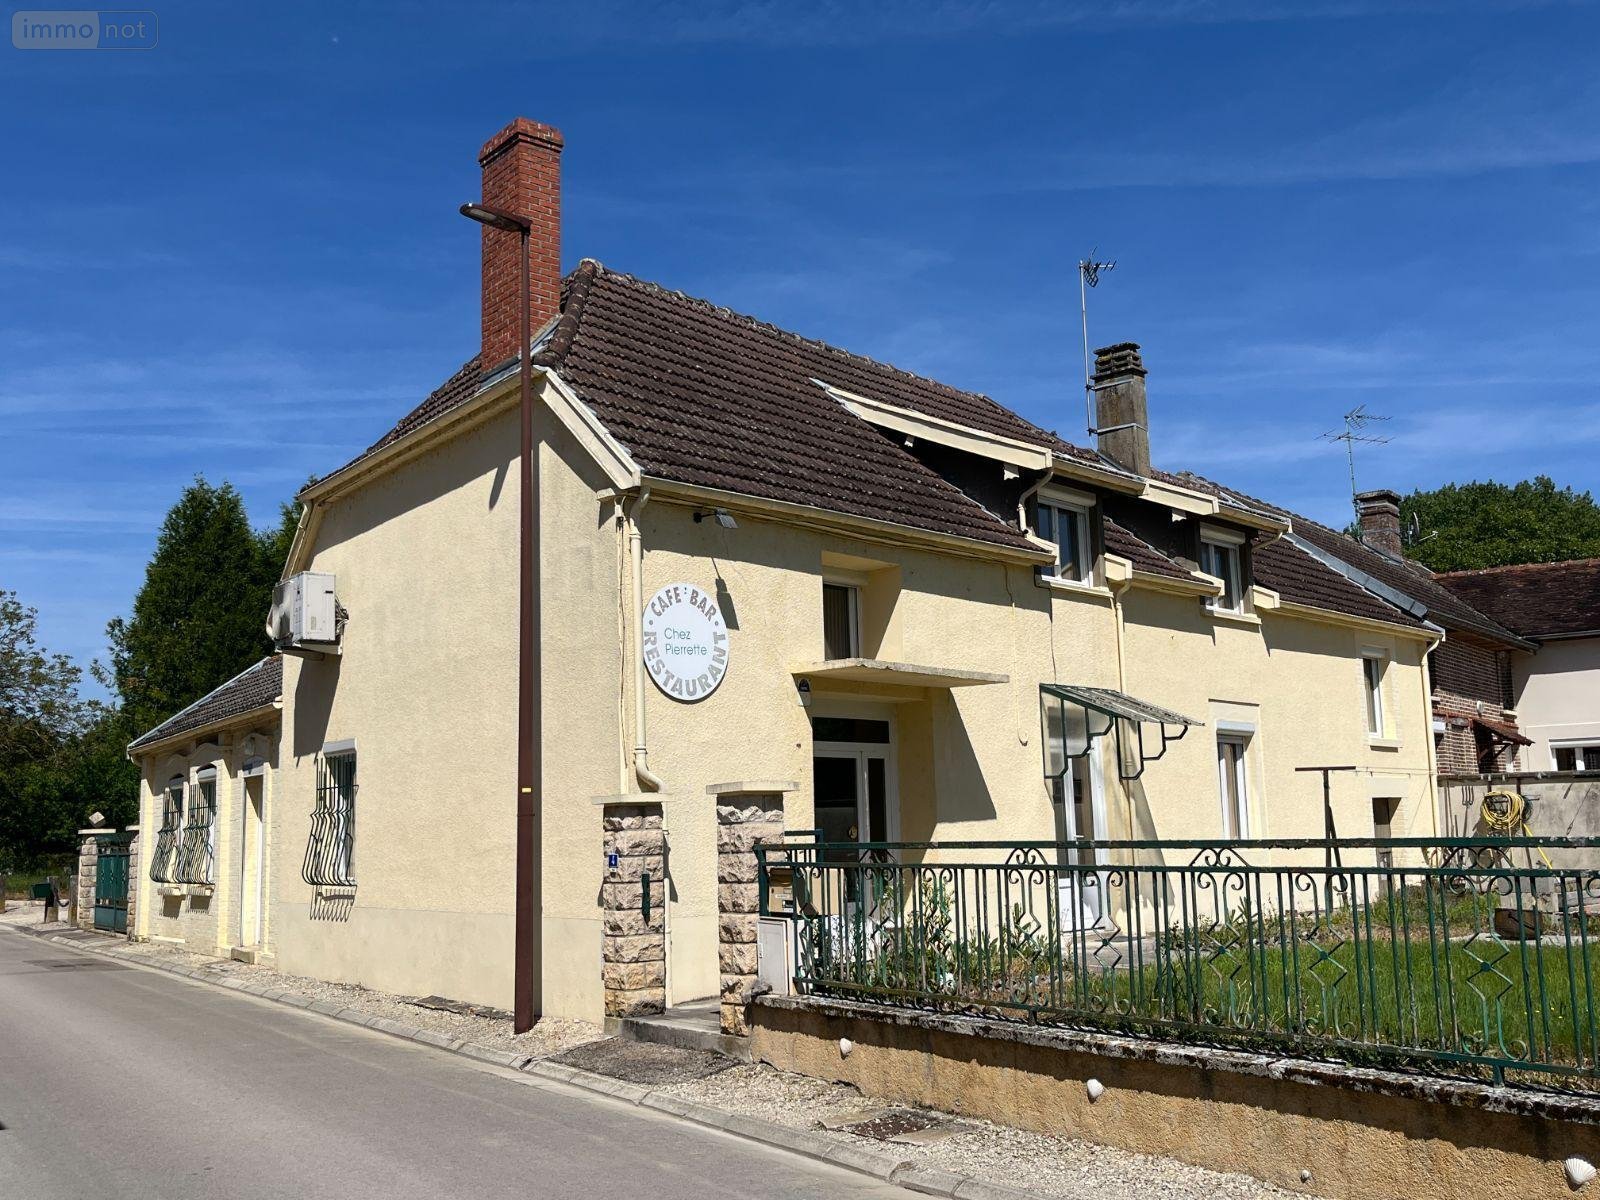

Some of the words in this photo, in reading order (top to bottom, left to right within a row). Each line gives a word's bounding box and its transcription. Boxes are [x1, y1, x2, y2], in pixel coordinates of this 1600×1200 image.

[689, 588, 717, 622] BAR
[664, 627, 691, 640] Chez
[665, 643, 708, 656] Pierrette
[644, 631, 727, 697] RESTAURANT
